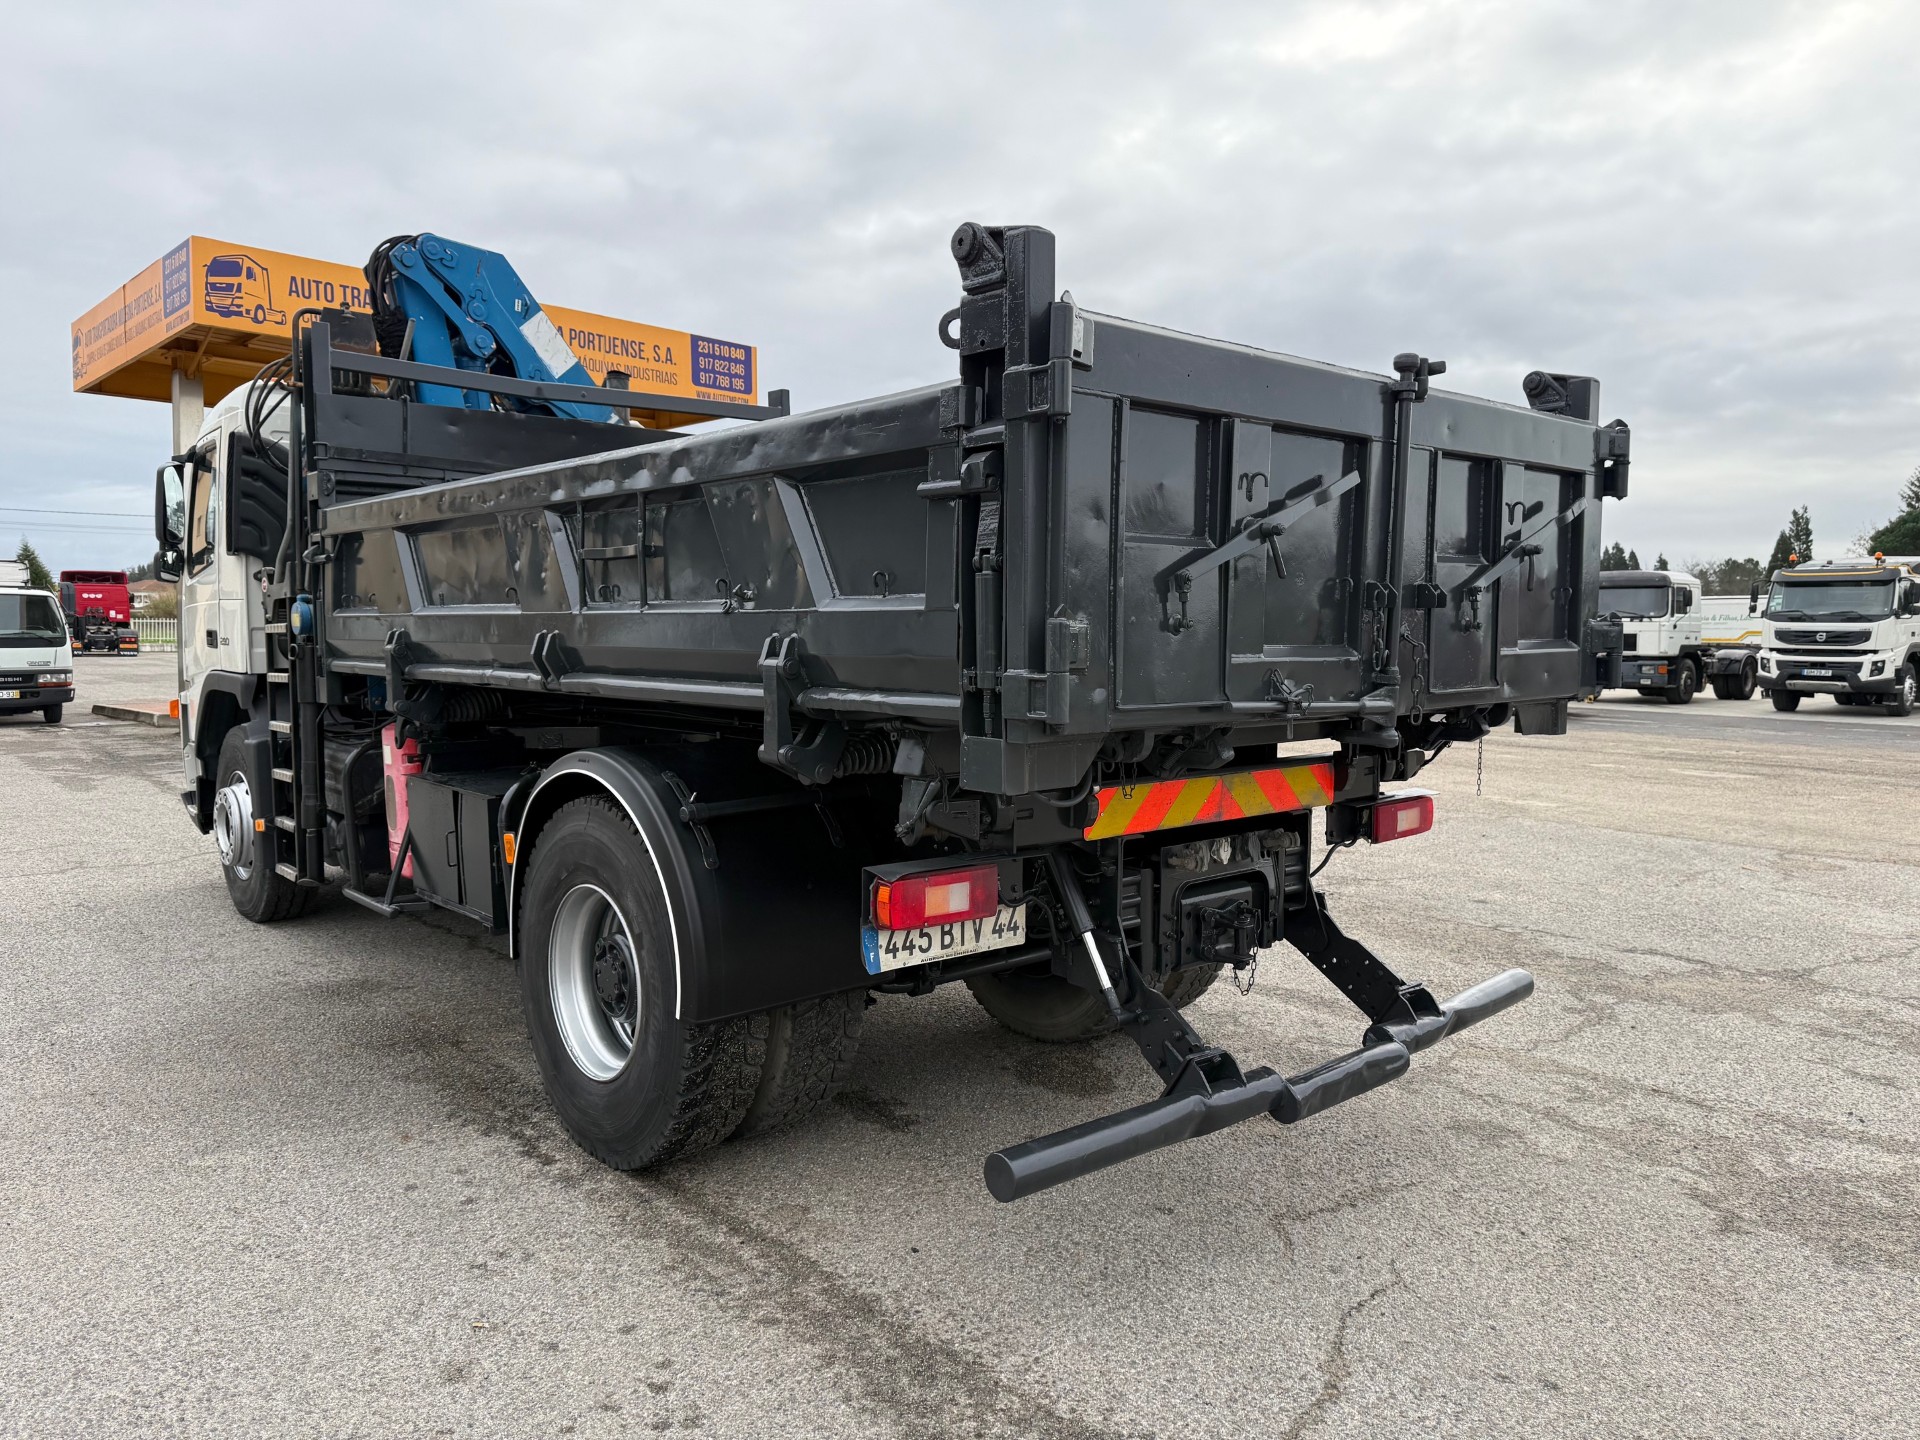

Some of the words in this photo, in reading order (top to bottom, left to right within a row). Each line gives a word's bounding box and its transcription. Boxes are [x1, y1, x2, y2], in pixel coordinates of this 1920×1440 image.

[288, 275, 335, 303] AUTO
[569, 328, 650, 363] PORTUENSE,
[653, 344, 677, 366] S.A.
[698, 340, 713, 355] 231
[714, 343, 729, 358] 510
[730, 346, 745, 361] 840
[698, 356, 713, 370] 917
[714, 359, 729, 373] 822
[730, 362, 745, 376] 846
[699, 371, 714, 385] 917
[715, 374, 730, 388] 768
[731, 377, 745, 391] 195
[885, 929, 933, 959] 445
[992, 906, 1020, 940] 44
[869, 952, 875, 963] F
